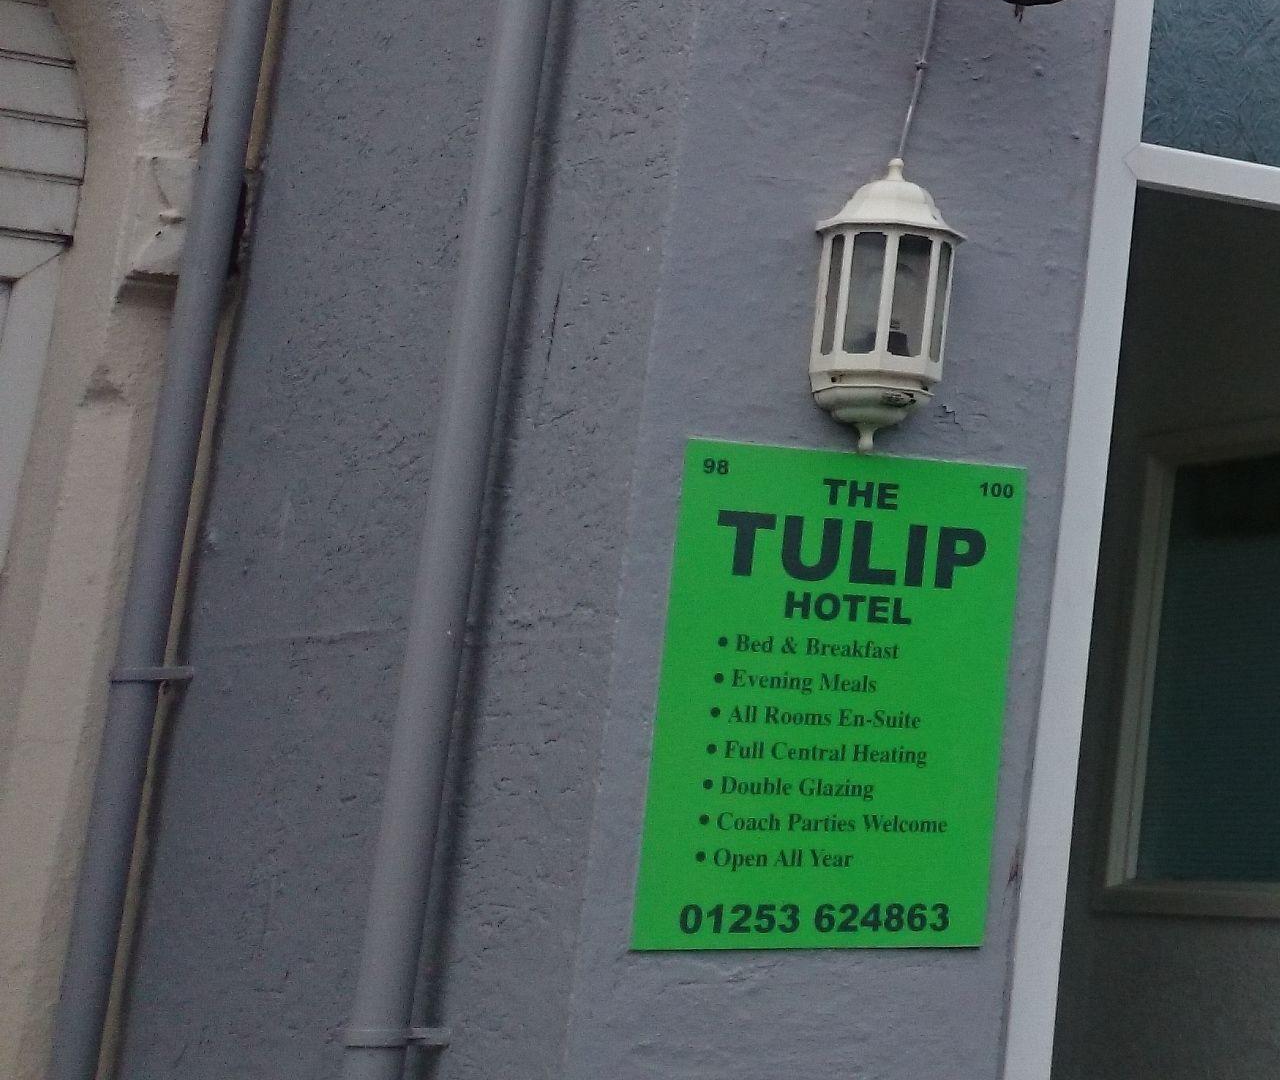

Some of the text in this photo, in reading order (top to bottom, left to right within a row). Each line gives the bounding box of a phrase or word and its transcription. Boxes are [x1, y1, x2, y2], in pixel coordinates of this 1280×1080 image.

[703, 458, 728, 475] 98
[823, 478, 899, 511] THE
[979, 482, 1014, 499] 100
[717, 510, 986, 589] TULIP
[785, 591, 911, 625] HOTEL
[736, 634, 899, 659] Bed & Breakfast
[732, 670, 877, 694] Evening Meals
[729, 706, 921, 730] All Rooms En-Suite
[725, 741, 927, 767] Full Central Heating
[721, 777, 874, 801] Double Glazing
[717, 813, 947, 834] Coach Parties Welcome
[713, 849, 854, 870] Open All Year
[679, 903, 950, 934] 01253 624863
